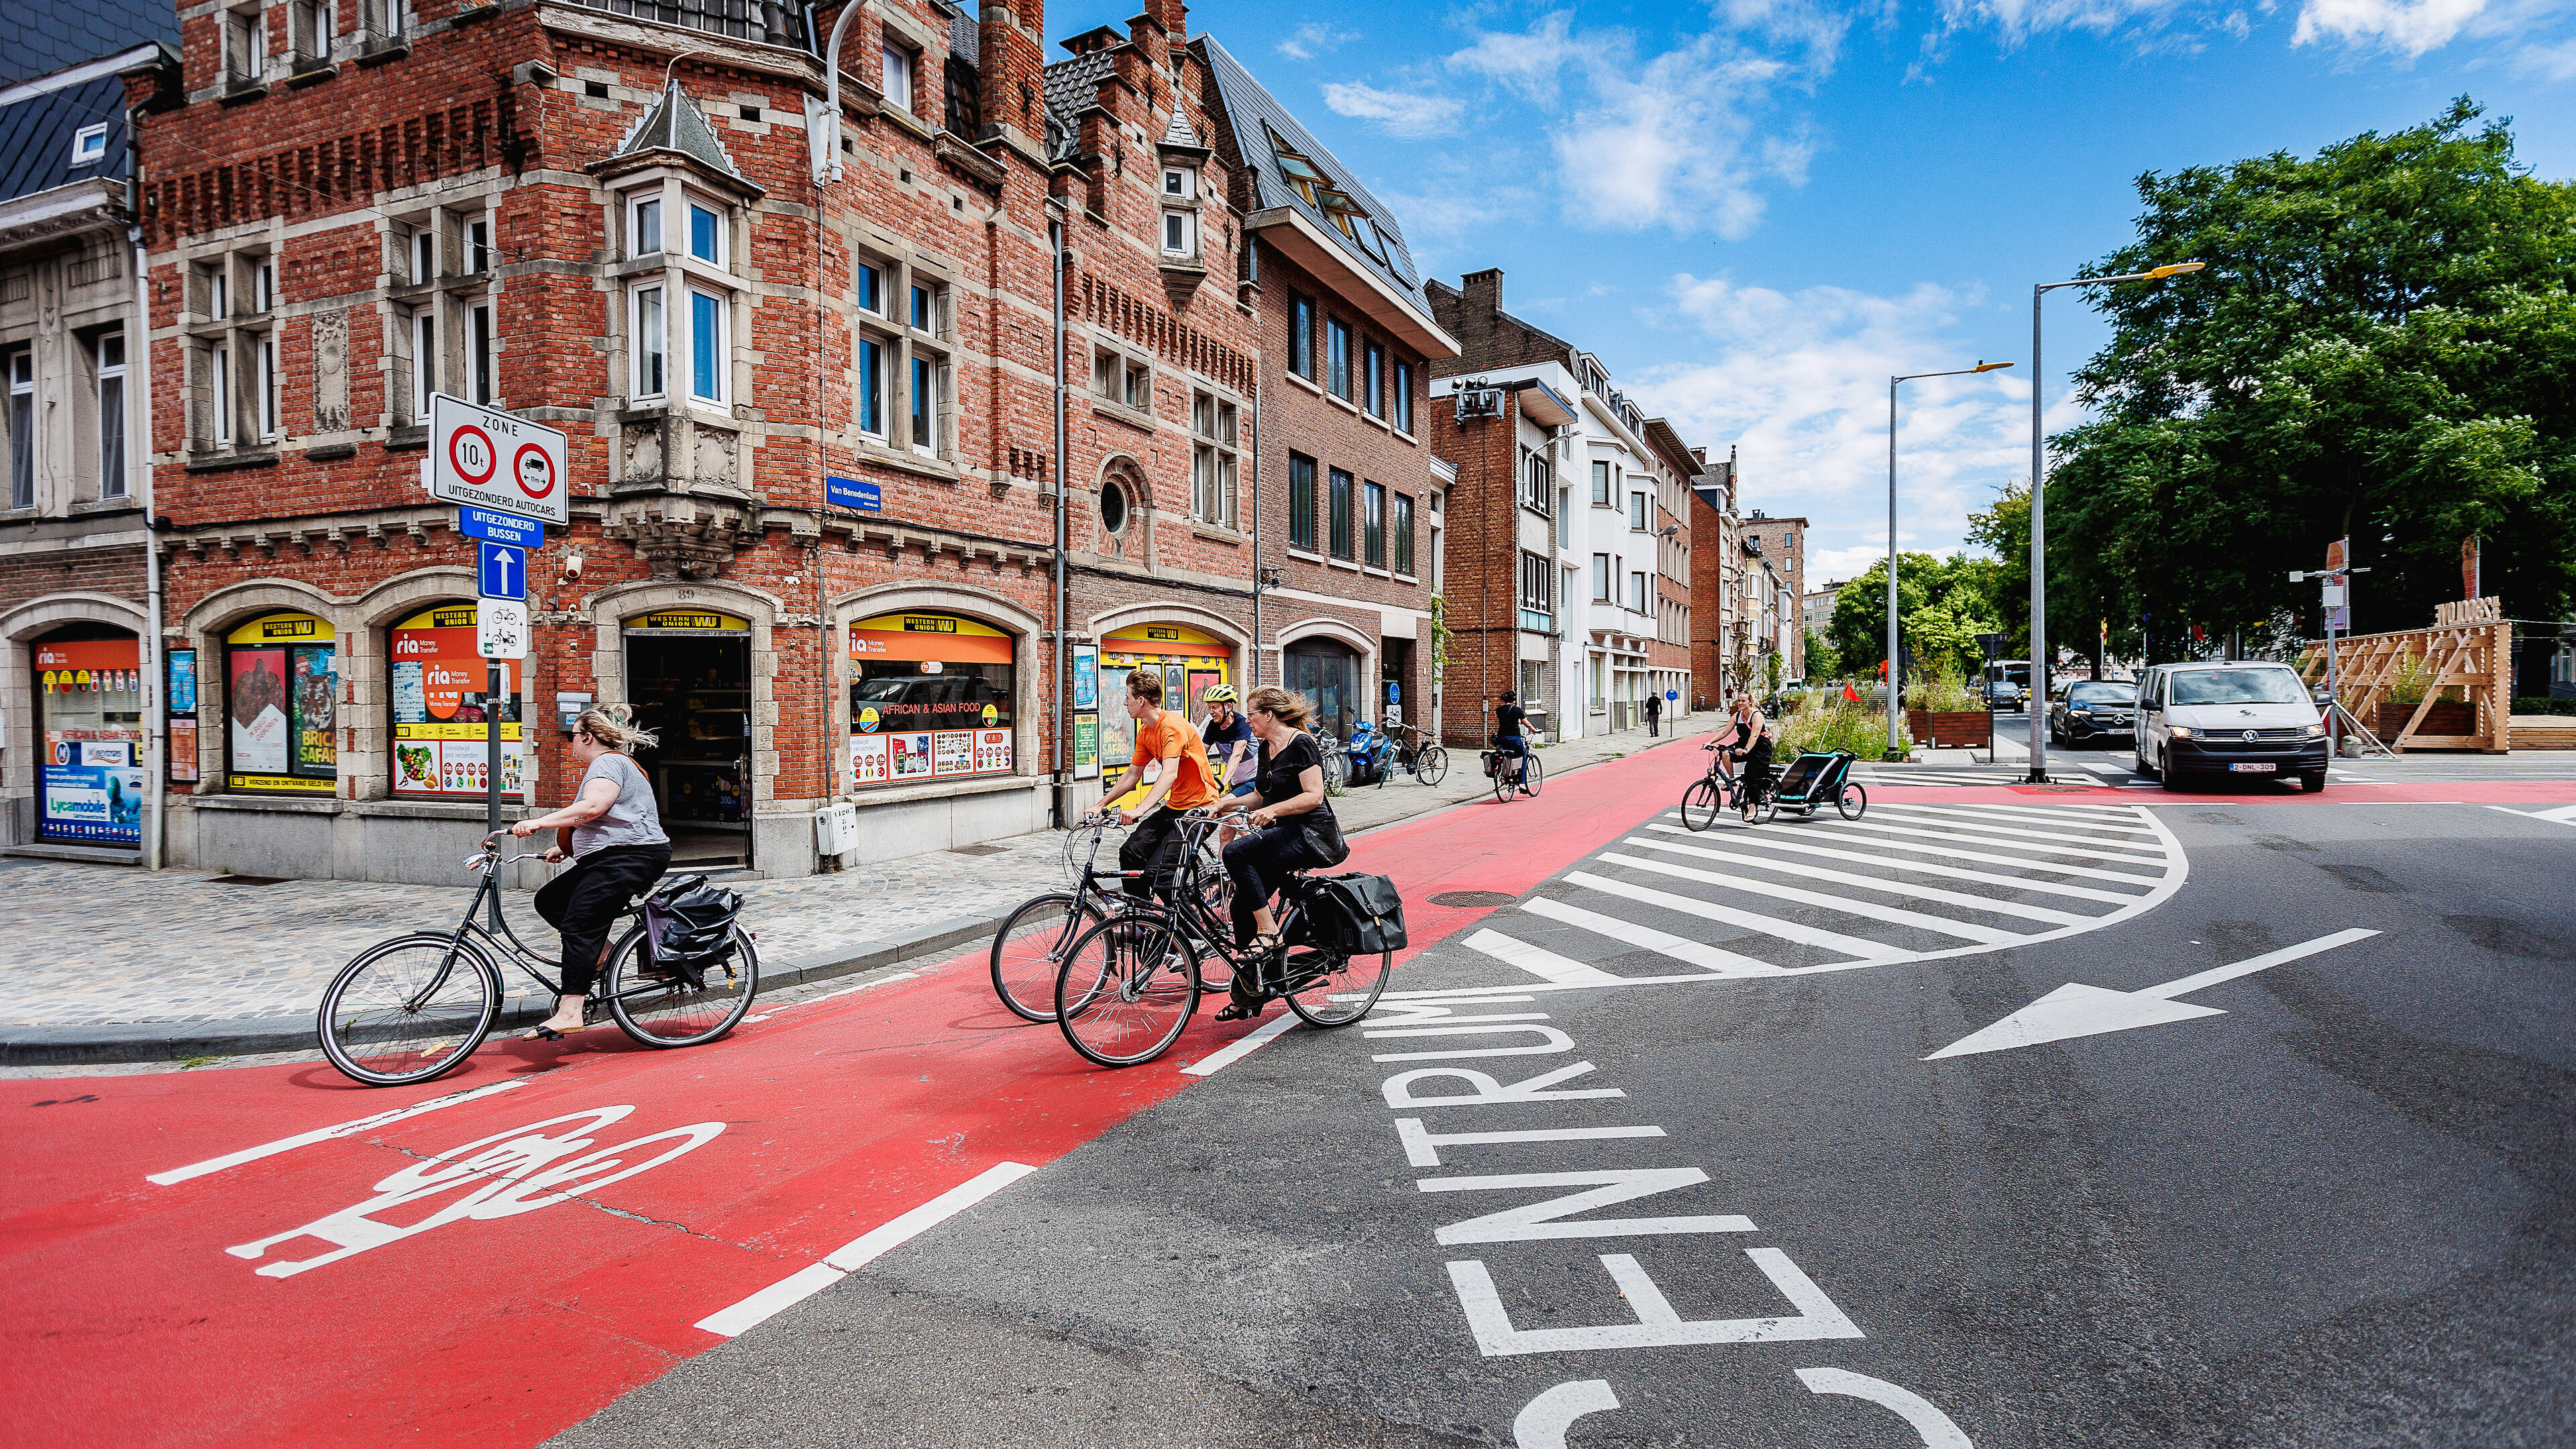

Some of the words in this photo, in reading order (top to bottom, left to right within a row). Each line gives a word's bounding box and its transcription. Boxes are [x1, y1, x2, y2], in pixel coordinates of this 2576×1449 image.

[483, 415, 519, 437] ZONE
[448, 484, 513, 507] UITGEZONDERD
[515, 499, 555, 517] AUTOCARS
[830, 484, 842, 494] Van
[843, 487, 878, 501] Benedenlaan
[472, 510, 535, 532] UITGEZONDERD
[487, 526, 521, 542] BUSSEN
[678, 589, 695, 600] 89
[295, 621, 312, 634] WU
[694, 616, 717, 627] WU
[937, 620, 953, 632] WU
[849, 632, 867, 652] ia
[868, 639, 885, 648] Money
[1167, 629, 1177, 639] WU
[396, 633, 419, 654] ria
[38, 647, 54, 664] ria
[427, 664, 450, 685] ria
[882, 704, 920, 715] AFRICAN
[923, 703, 929, 714] &
[932, 702, 957, 713] ASIAN
[959, 702, 981, 712] FOOD
[299, 747, 336, 764] SAFAR
[50, 797, 107, 814] Lycamobile
